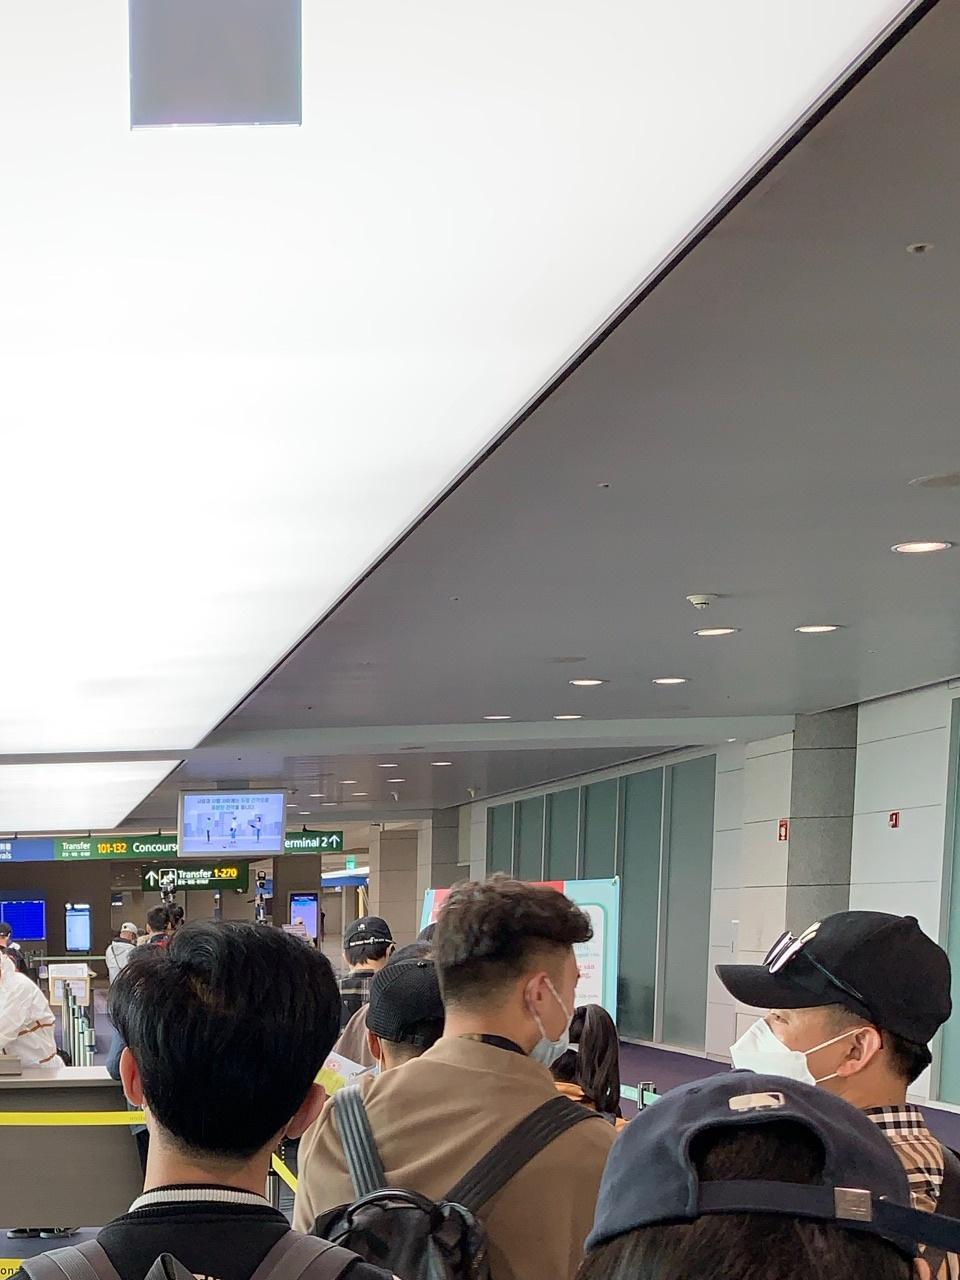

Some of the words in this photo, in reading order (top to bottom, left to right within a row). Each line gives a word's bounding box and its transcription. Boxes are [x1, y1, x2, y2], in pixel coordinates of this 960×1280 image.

[62, 842, 91, 850] Transfer
[97, 843, 128, 854] 101-132
[132, 842, 179, 853] Concours
[284, 837, 320, 848] erminal
[321, 836, 328, 848] 2
[178, 869, 213, 879] Transfer
[213, 867, 238, 878] 1-270
